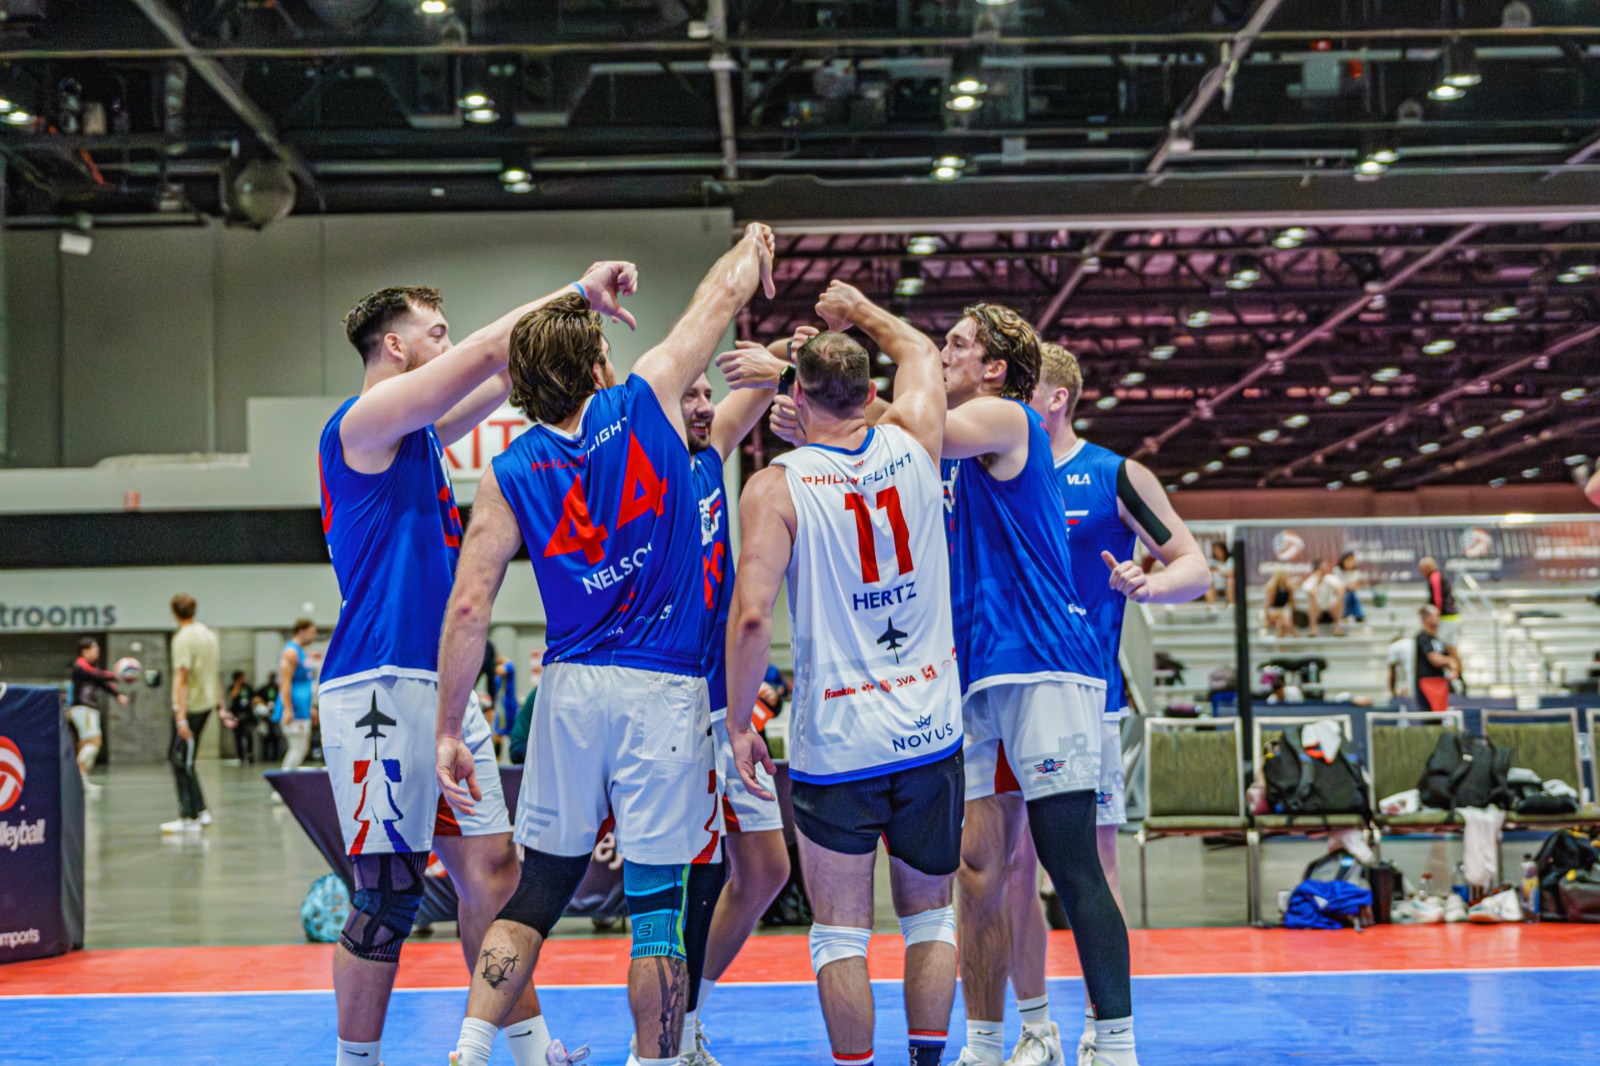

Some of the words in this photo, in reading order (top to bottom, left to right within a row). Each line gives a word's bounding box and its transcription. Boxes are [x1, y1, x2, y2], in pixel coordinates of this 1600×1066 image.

[1066, 473, 1091, 485] VLA
[543, 427, 668, 566] 44
[844, 485, 914, 584] 11
[582, 541, 652, 595] NELSO
[852, 582, 917, 611] HERTZ
[895, 675, 917, 688] JVA
[892, 722, 954, 752] NOVUS
